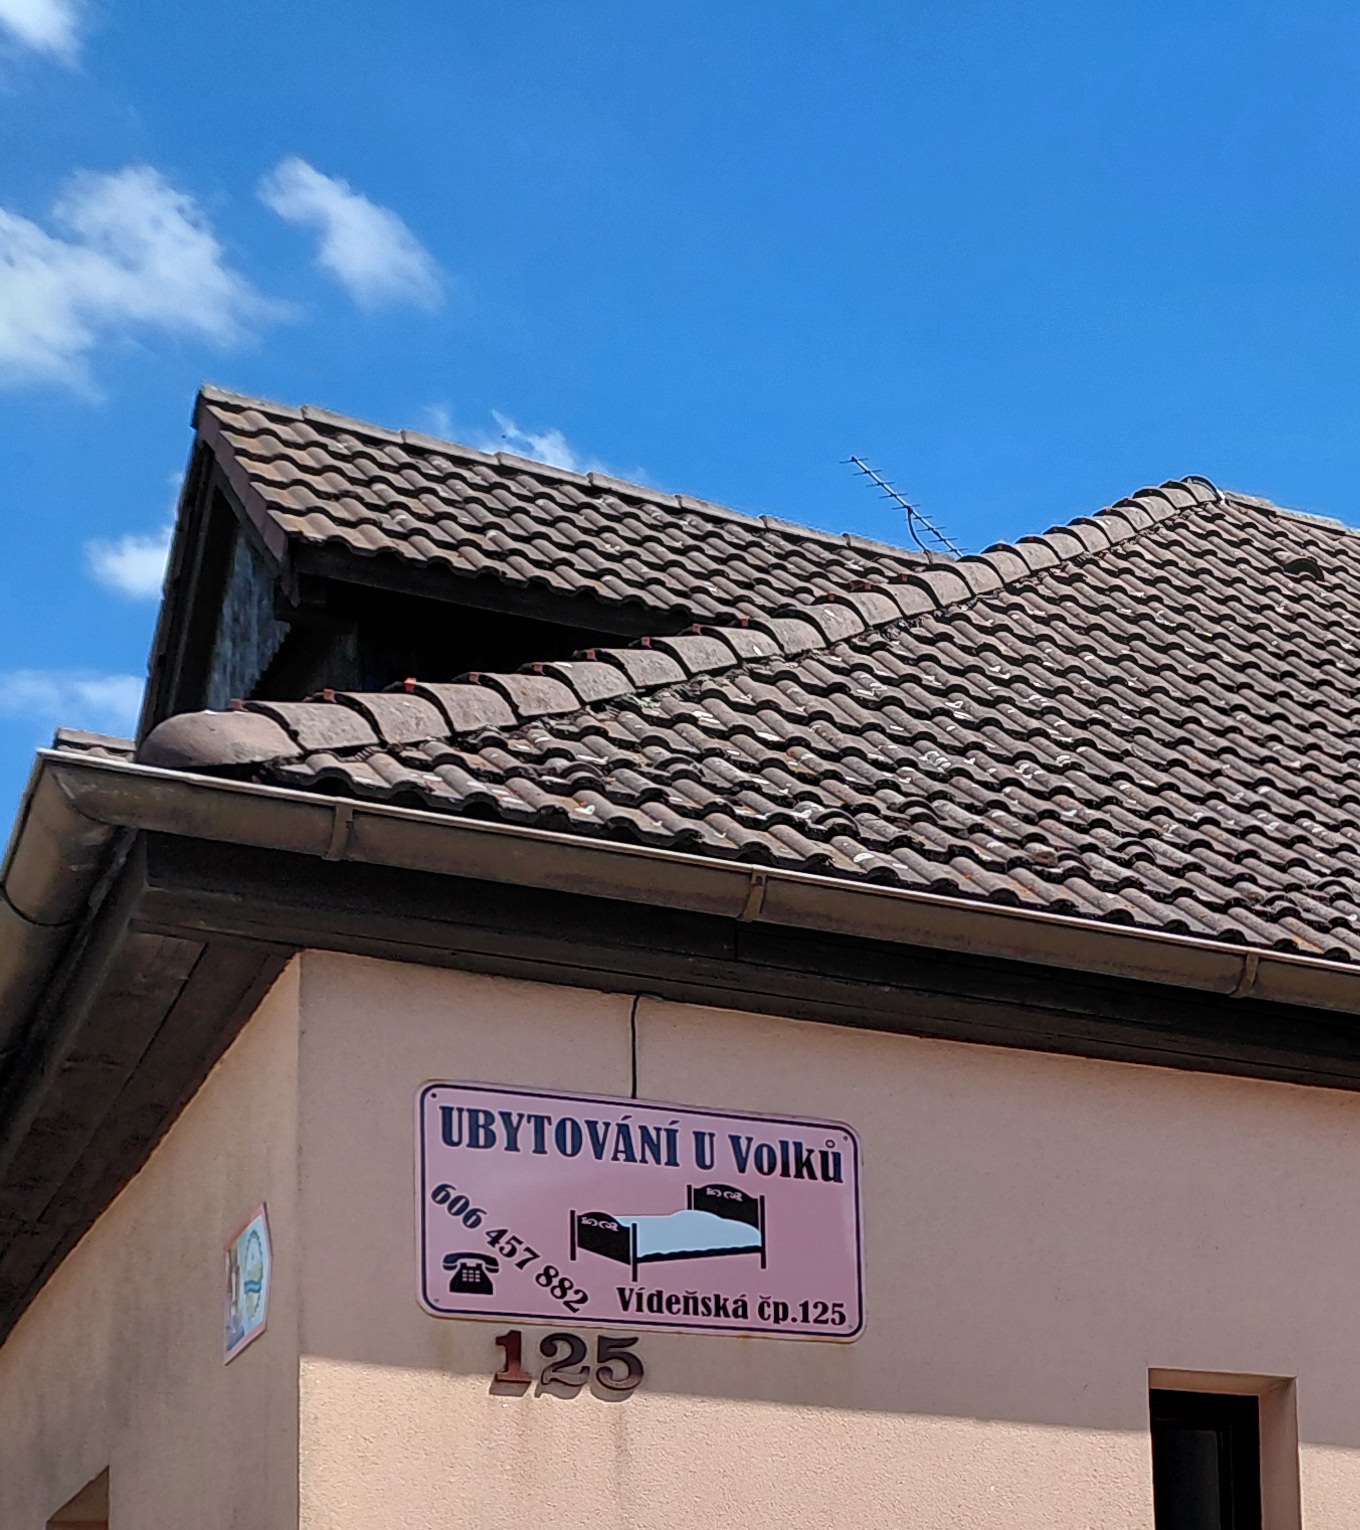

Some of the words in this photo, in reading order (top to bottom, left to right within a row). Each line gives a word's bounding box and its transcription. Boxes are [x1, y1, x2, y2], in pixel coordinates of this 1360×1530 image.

[438, 1105, 681, 1168] UBYTOVÁNÍ
[692, 1130, 716, 1171] U
[727, 1134, 844, 1184] Volků
[431, 1183, 488, 1229] 606
[485, 1228, 540, 1271] 457
[535, 1264, 589, 1314] 882
[616, 1286, 749, 1320] Vídeňská
[757, 1294, 847, 1326] čp.125
[494, 1329, 645, 1391] 125
